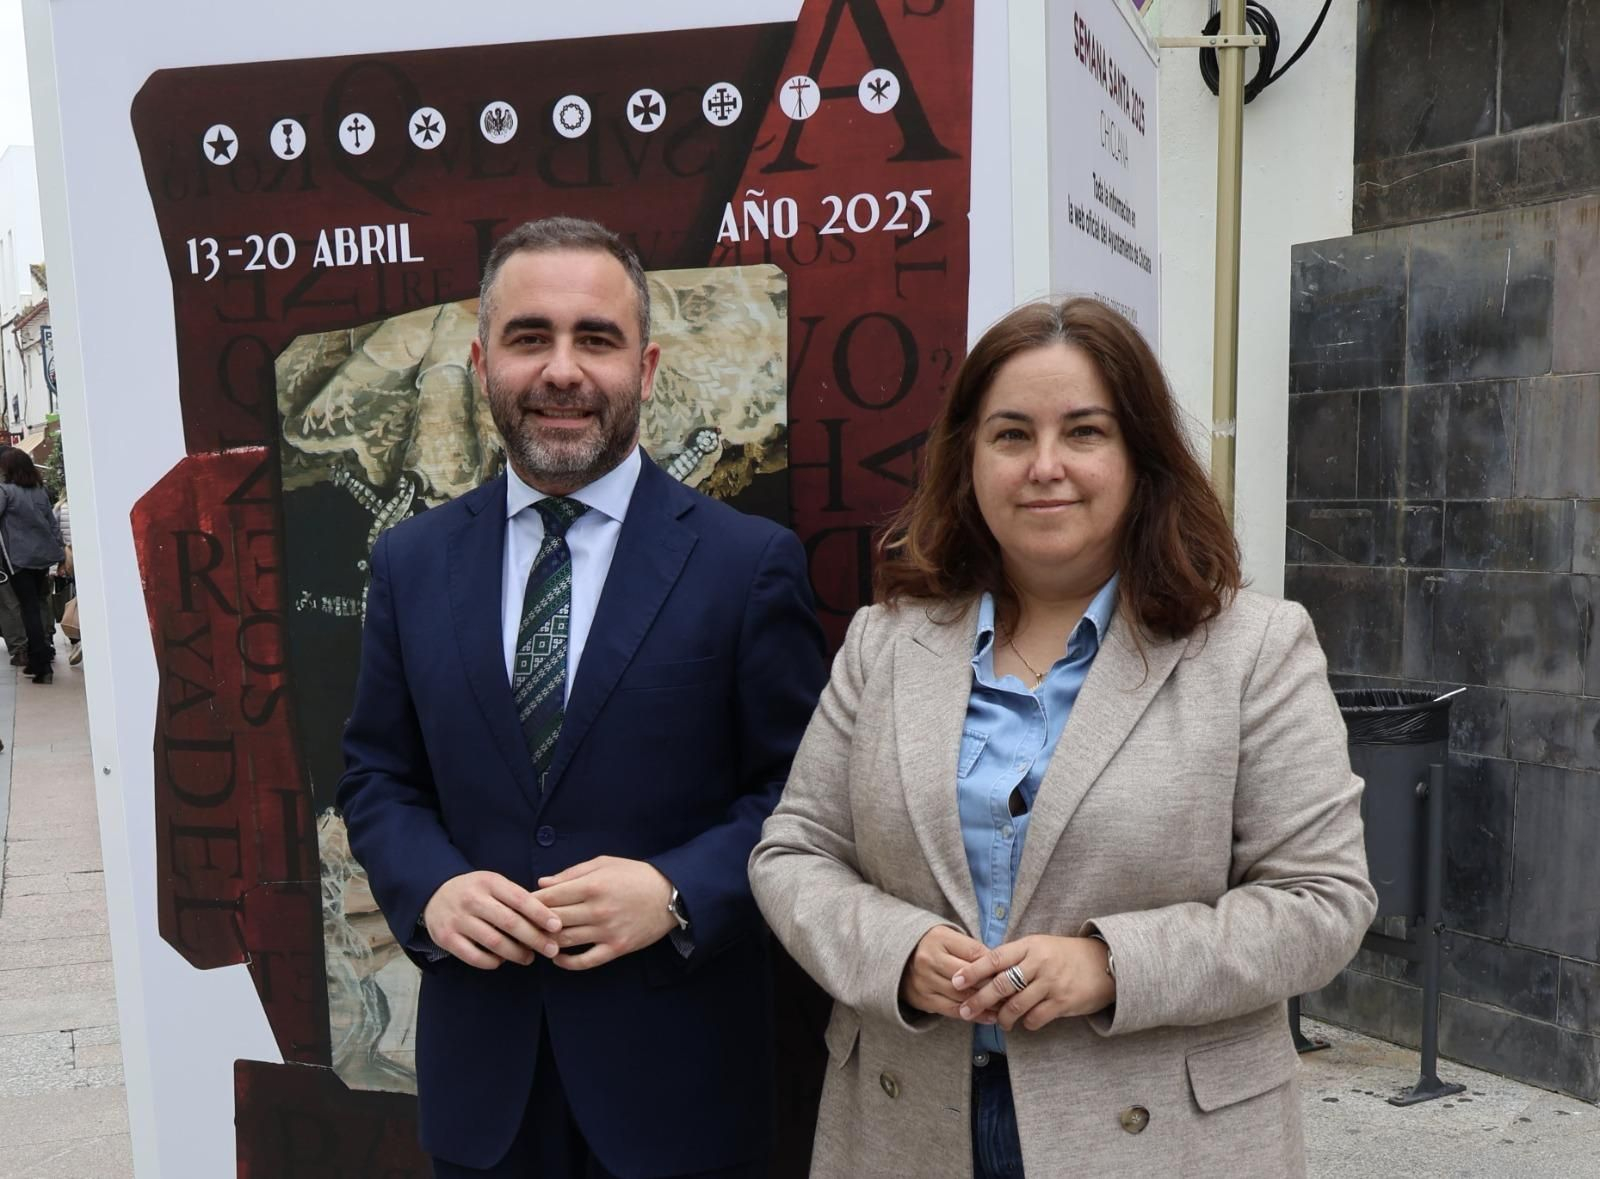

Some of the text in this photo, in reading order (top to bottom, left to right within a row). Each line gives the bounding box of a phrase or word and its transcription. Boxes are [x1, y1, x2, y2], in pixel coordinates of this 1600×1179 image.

[1074, 10, 1145, 136] SEMANA SANTA 2025
[1092, 171, 1104, 204] Toda
[717, 188, 933, 243] AÑO 2025
[1068, 192, 1074, 225] la
[1074, 202, 1085, 232] web
[1086, 209, 1100, 241] oficial
[186, 231, 297, 283] 13-20
[312, 222, 426, 268] ABRIL
